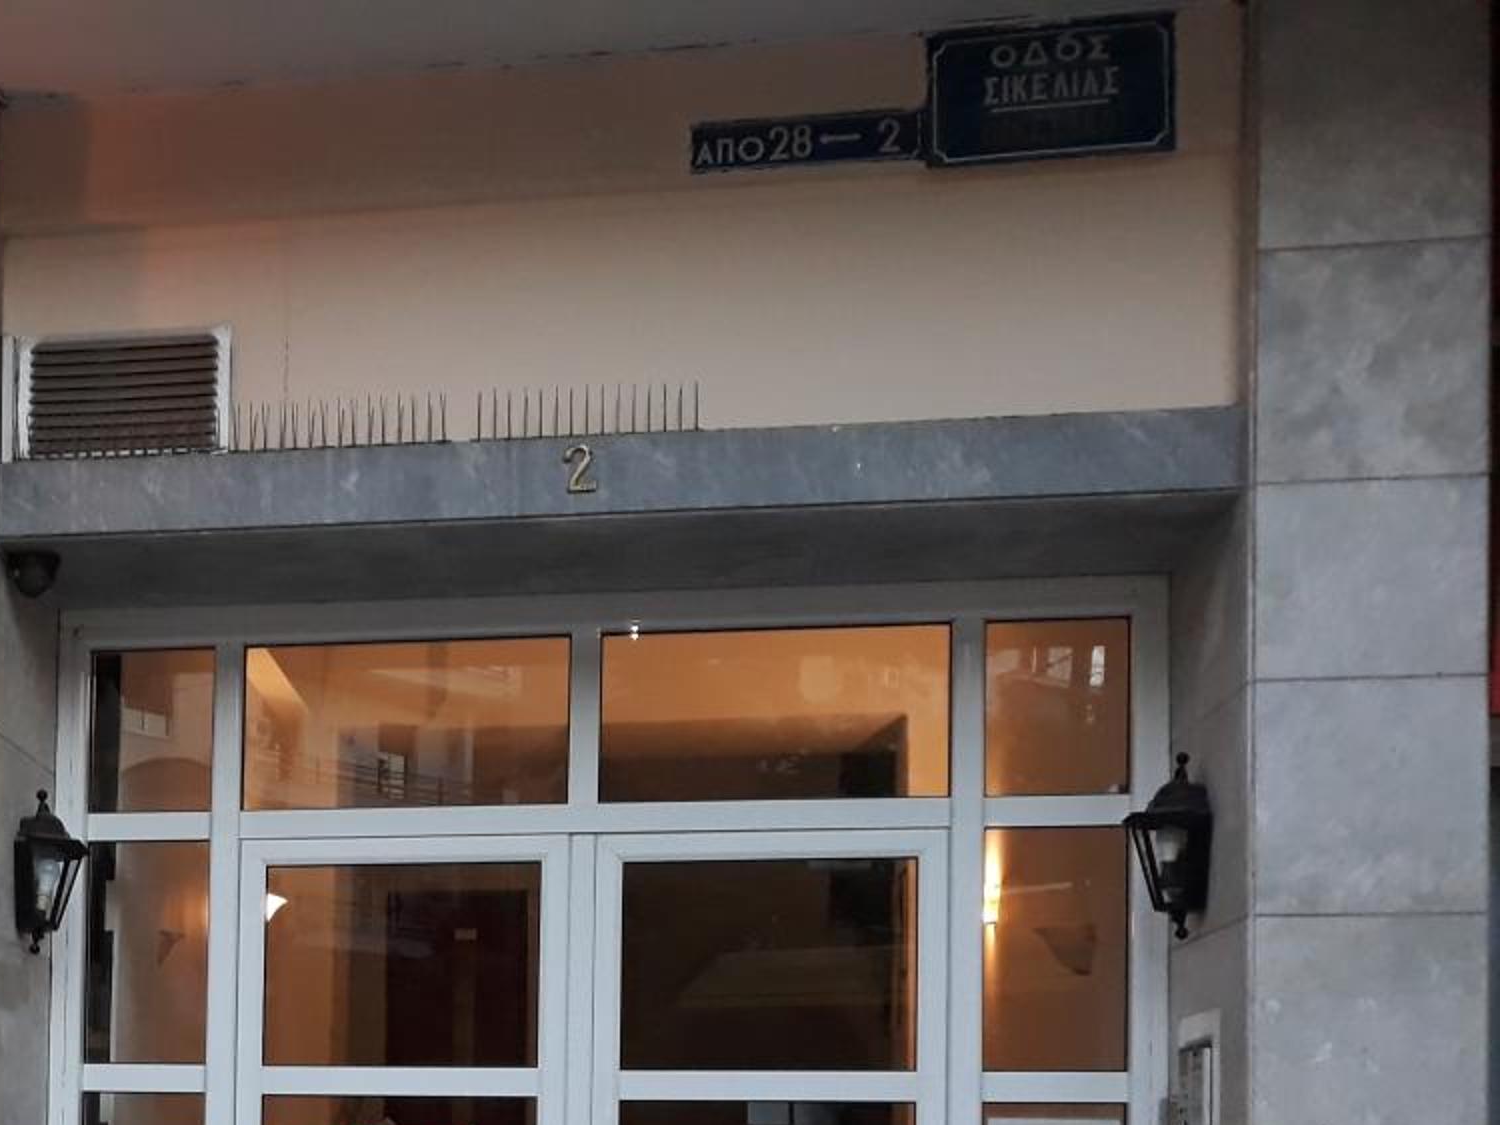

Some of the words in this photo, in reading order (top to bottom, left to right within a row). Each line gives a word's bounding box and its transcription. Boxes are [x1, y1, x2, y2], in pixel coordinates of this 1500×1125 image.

[983, 66, 1120, 105] ΣΙΚΕΛΙΑΣ
[768, 124, 813, 160] 28
[878, 117, 901, 152] 2
[562, 443, 598, 494] 2
